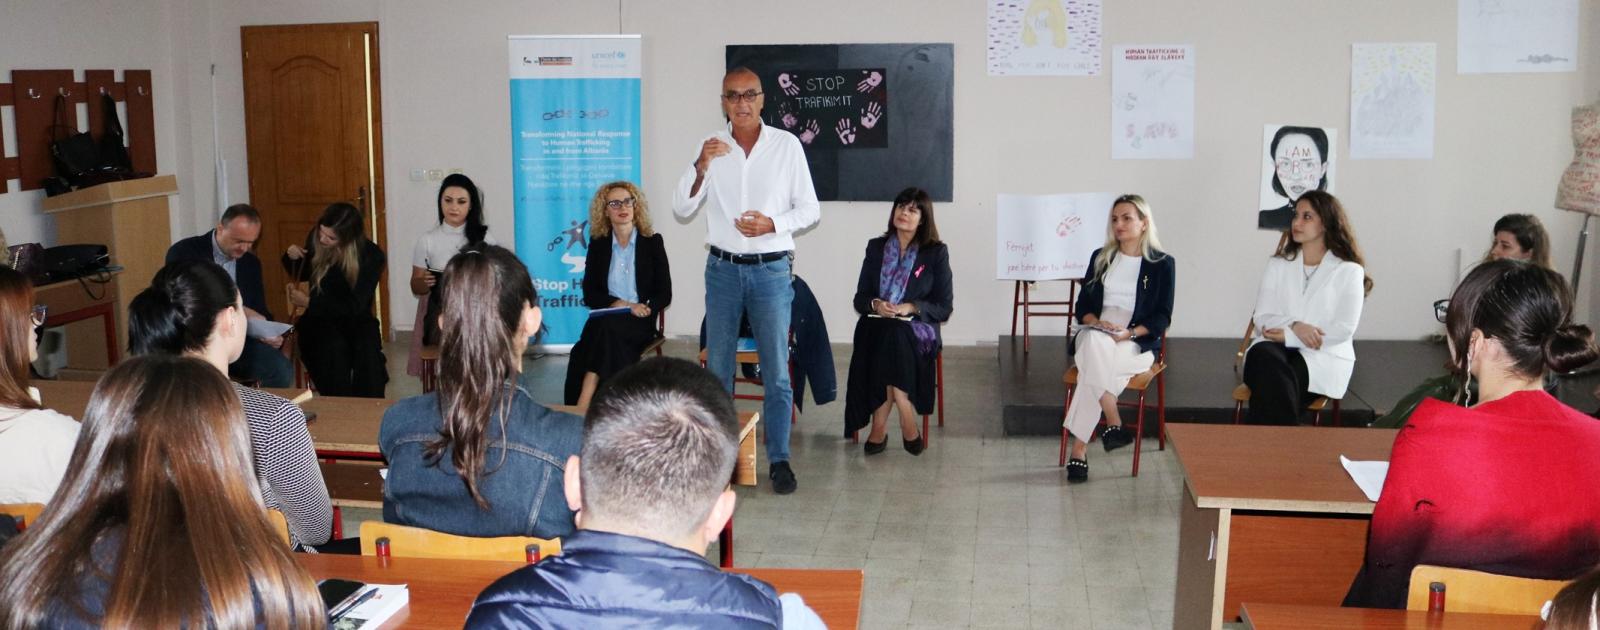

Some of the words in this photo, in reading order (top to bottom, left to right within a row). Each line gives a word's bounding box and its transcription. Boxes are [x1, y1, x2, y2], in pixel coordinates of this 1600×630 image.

[592, 51, 615, 59] unicef
[806, 76, 845, 91] STOP
[597, 130, 631, 138] Response
[1292, 146, 1311, 157] AM
[533, 279, 568, 293] Stop
[538, 295, 587, 307] Traffic
